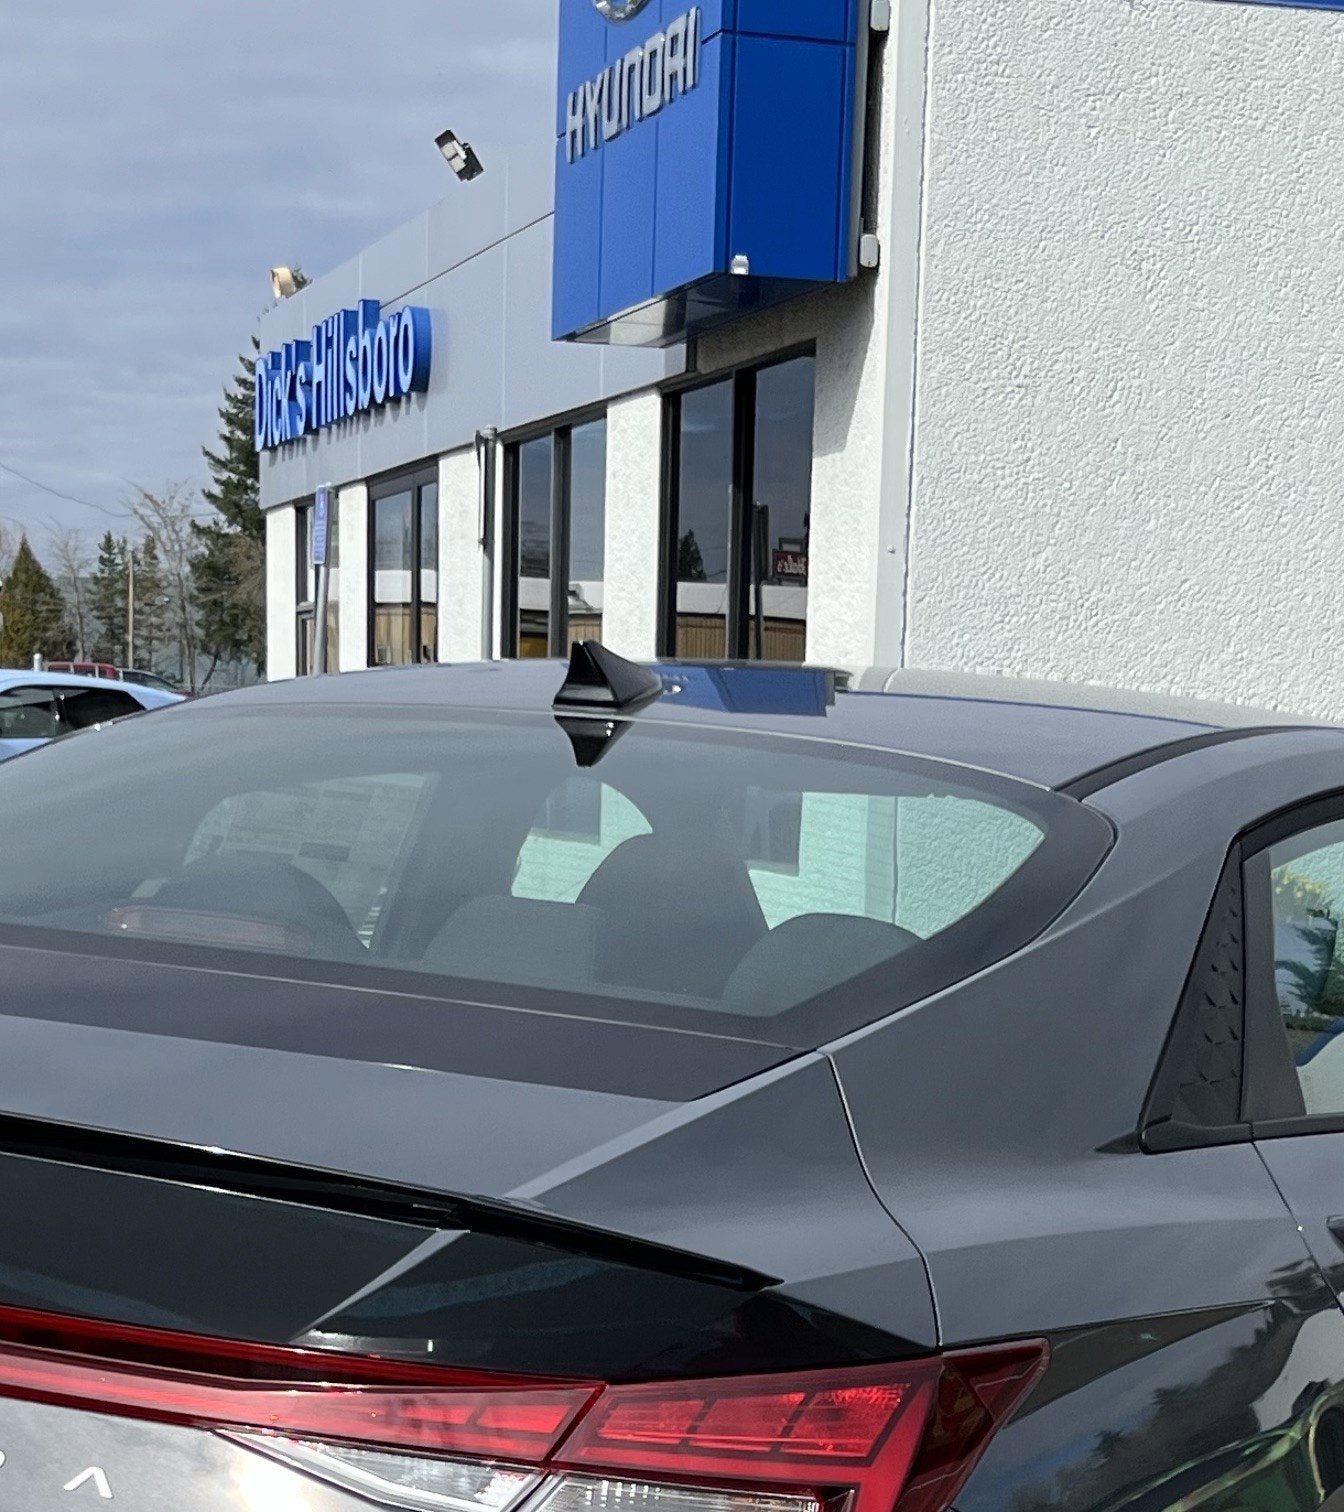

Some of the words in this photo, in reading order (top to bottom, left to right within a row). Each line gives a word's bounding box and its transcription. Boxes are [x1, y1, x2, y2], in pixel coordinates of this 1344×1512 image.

[566, 6, 700, 164] HYUNDAI
[255, 340, 308, 452] Dick's
[311, 300, 424, 430] Hillsboro
